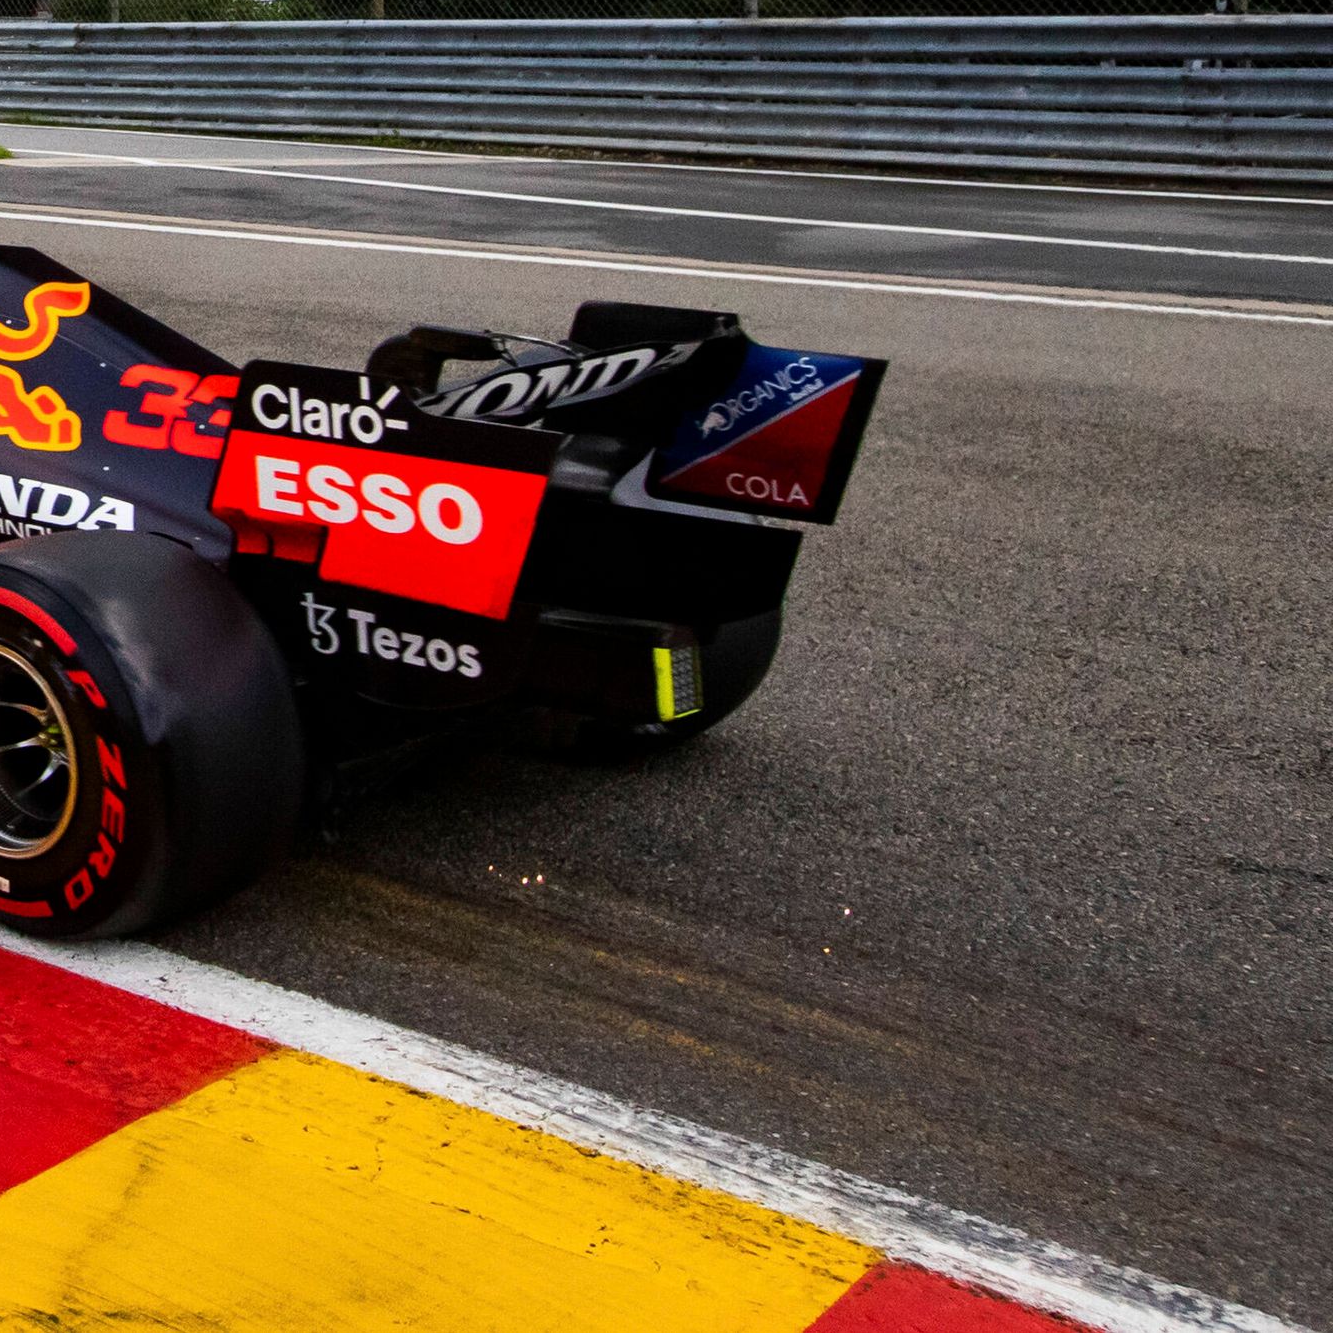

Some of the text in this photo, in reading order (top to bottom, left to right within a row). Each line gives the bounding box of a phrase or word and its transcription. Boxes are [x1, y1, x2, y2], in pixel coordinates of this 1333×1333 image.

[708, 356, 818, 431] ORGANICS
[255, 454, 483, 546] ESSO
[725, 472, 810, 506] COLA
[346, 608, 483, 679] Tezos
[63, 733, 128, 912] ZERO
